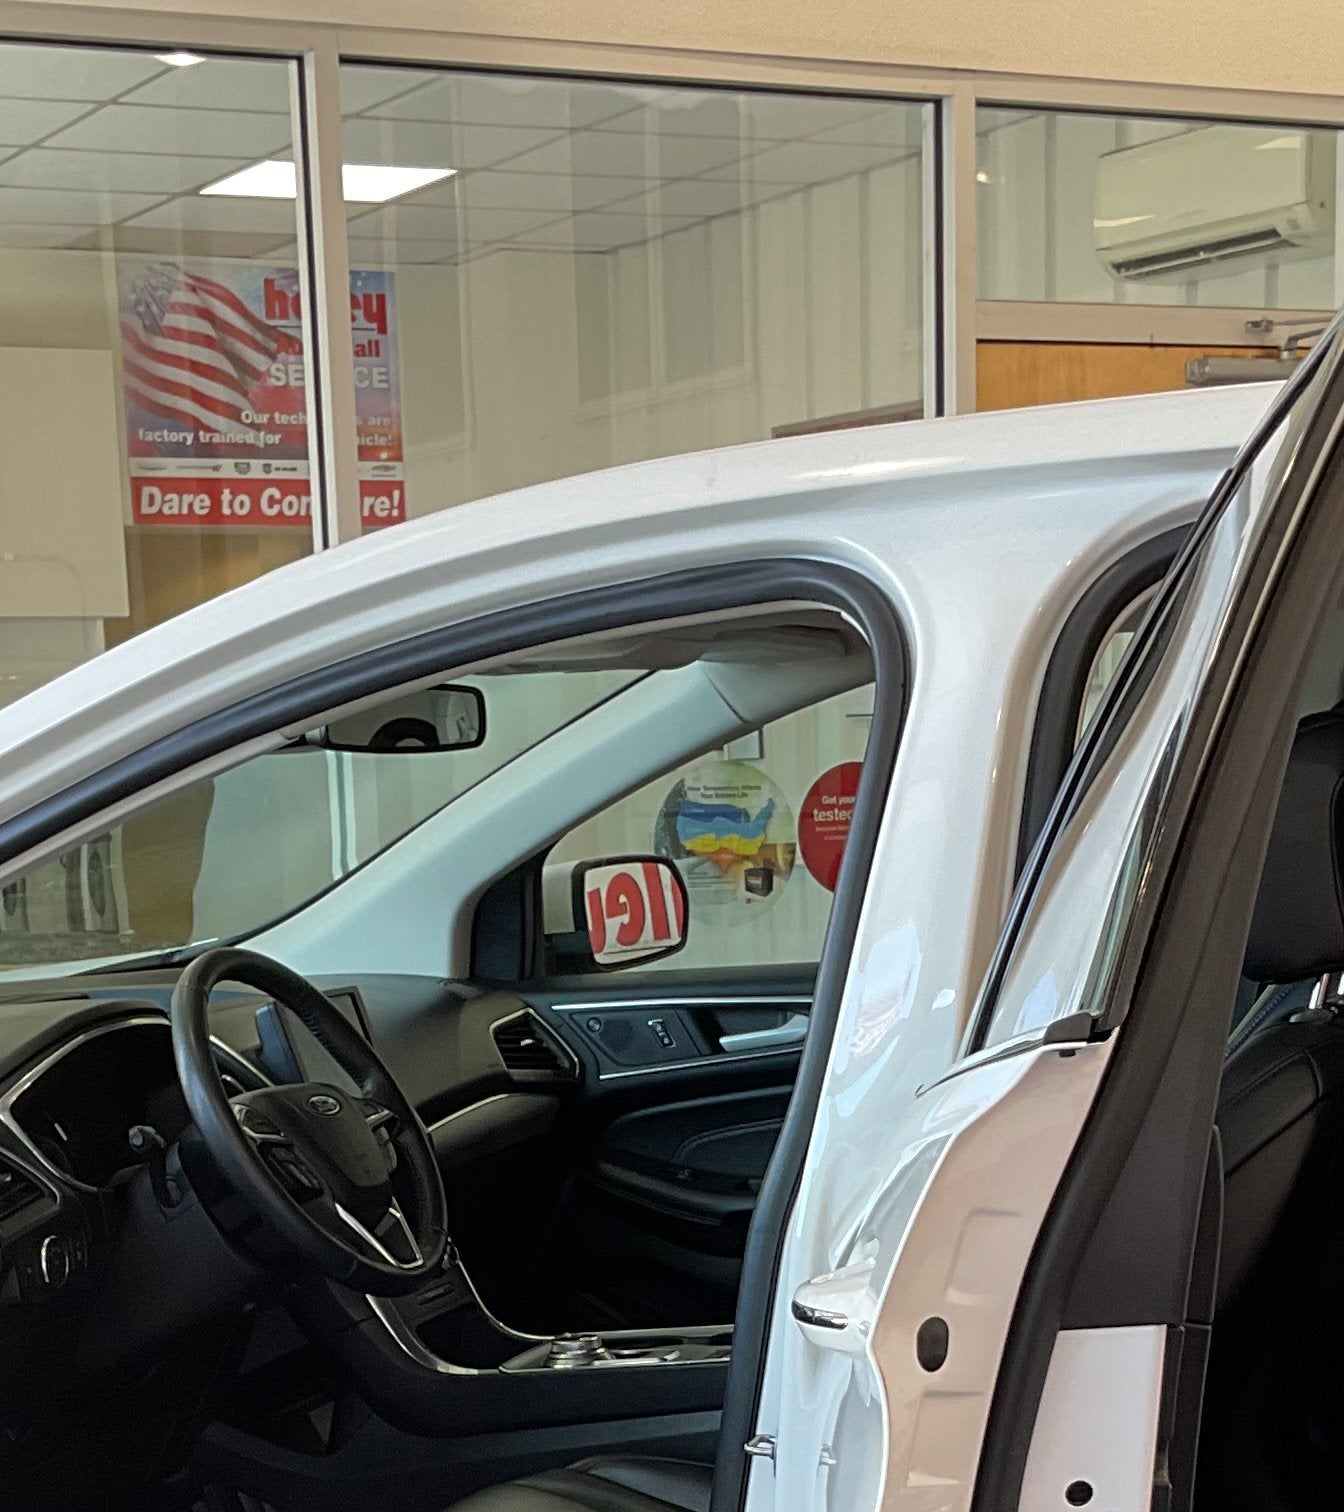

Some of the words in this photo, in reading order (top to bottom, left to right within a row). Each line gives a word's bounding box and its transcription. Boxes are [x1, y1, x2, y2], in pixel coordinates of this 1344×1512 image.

[240, 412, 269, 425] Our
[138, 428, 194, 445] factory
[199, 429, 255, 444] trained
[258, 431, 282, 447] for
[140, 486, 212, 515] Dare
[221, 488, 251, 516] to
[821, 795, 837, 805] Get
